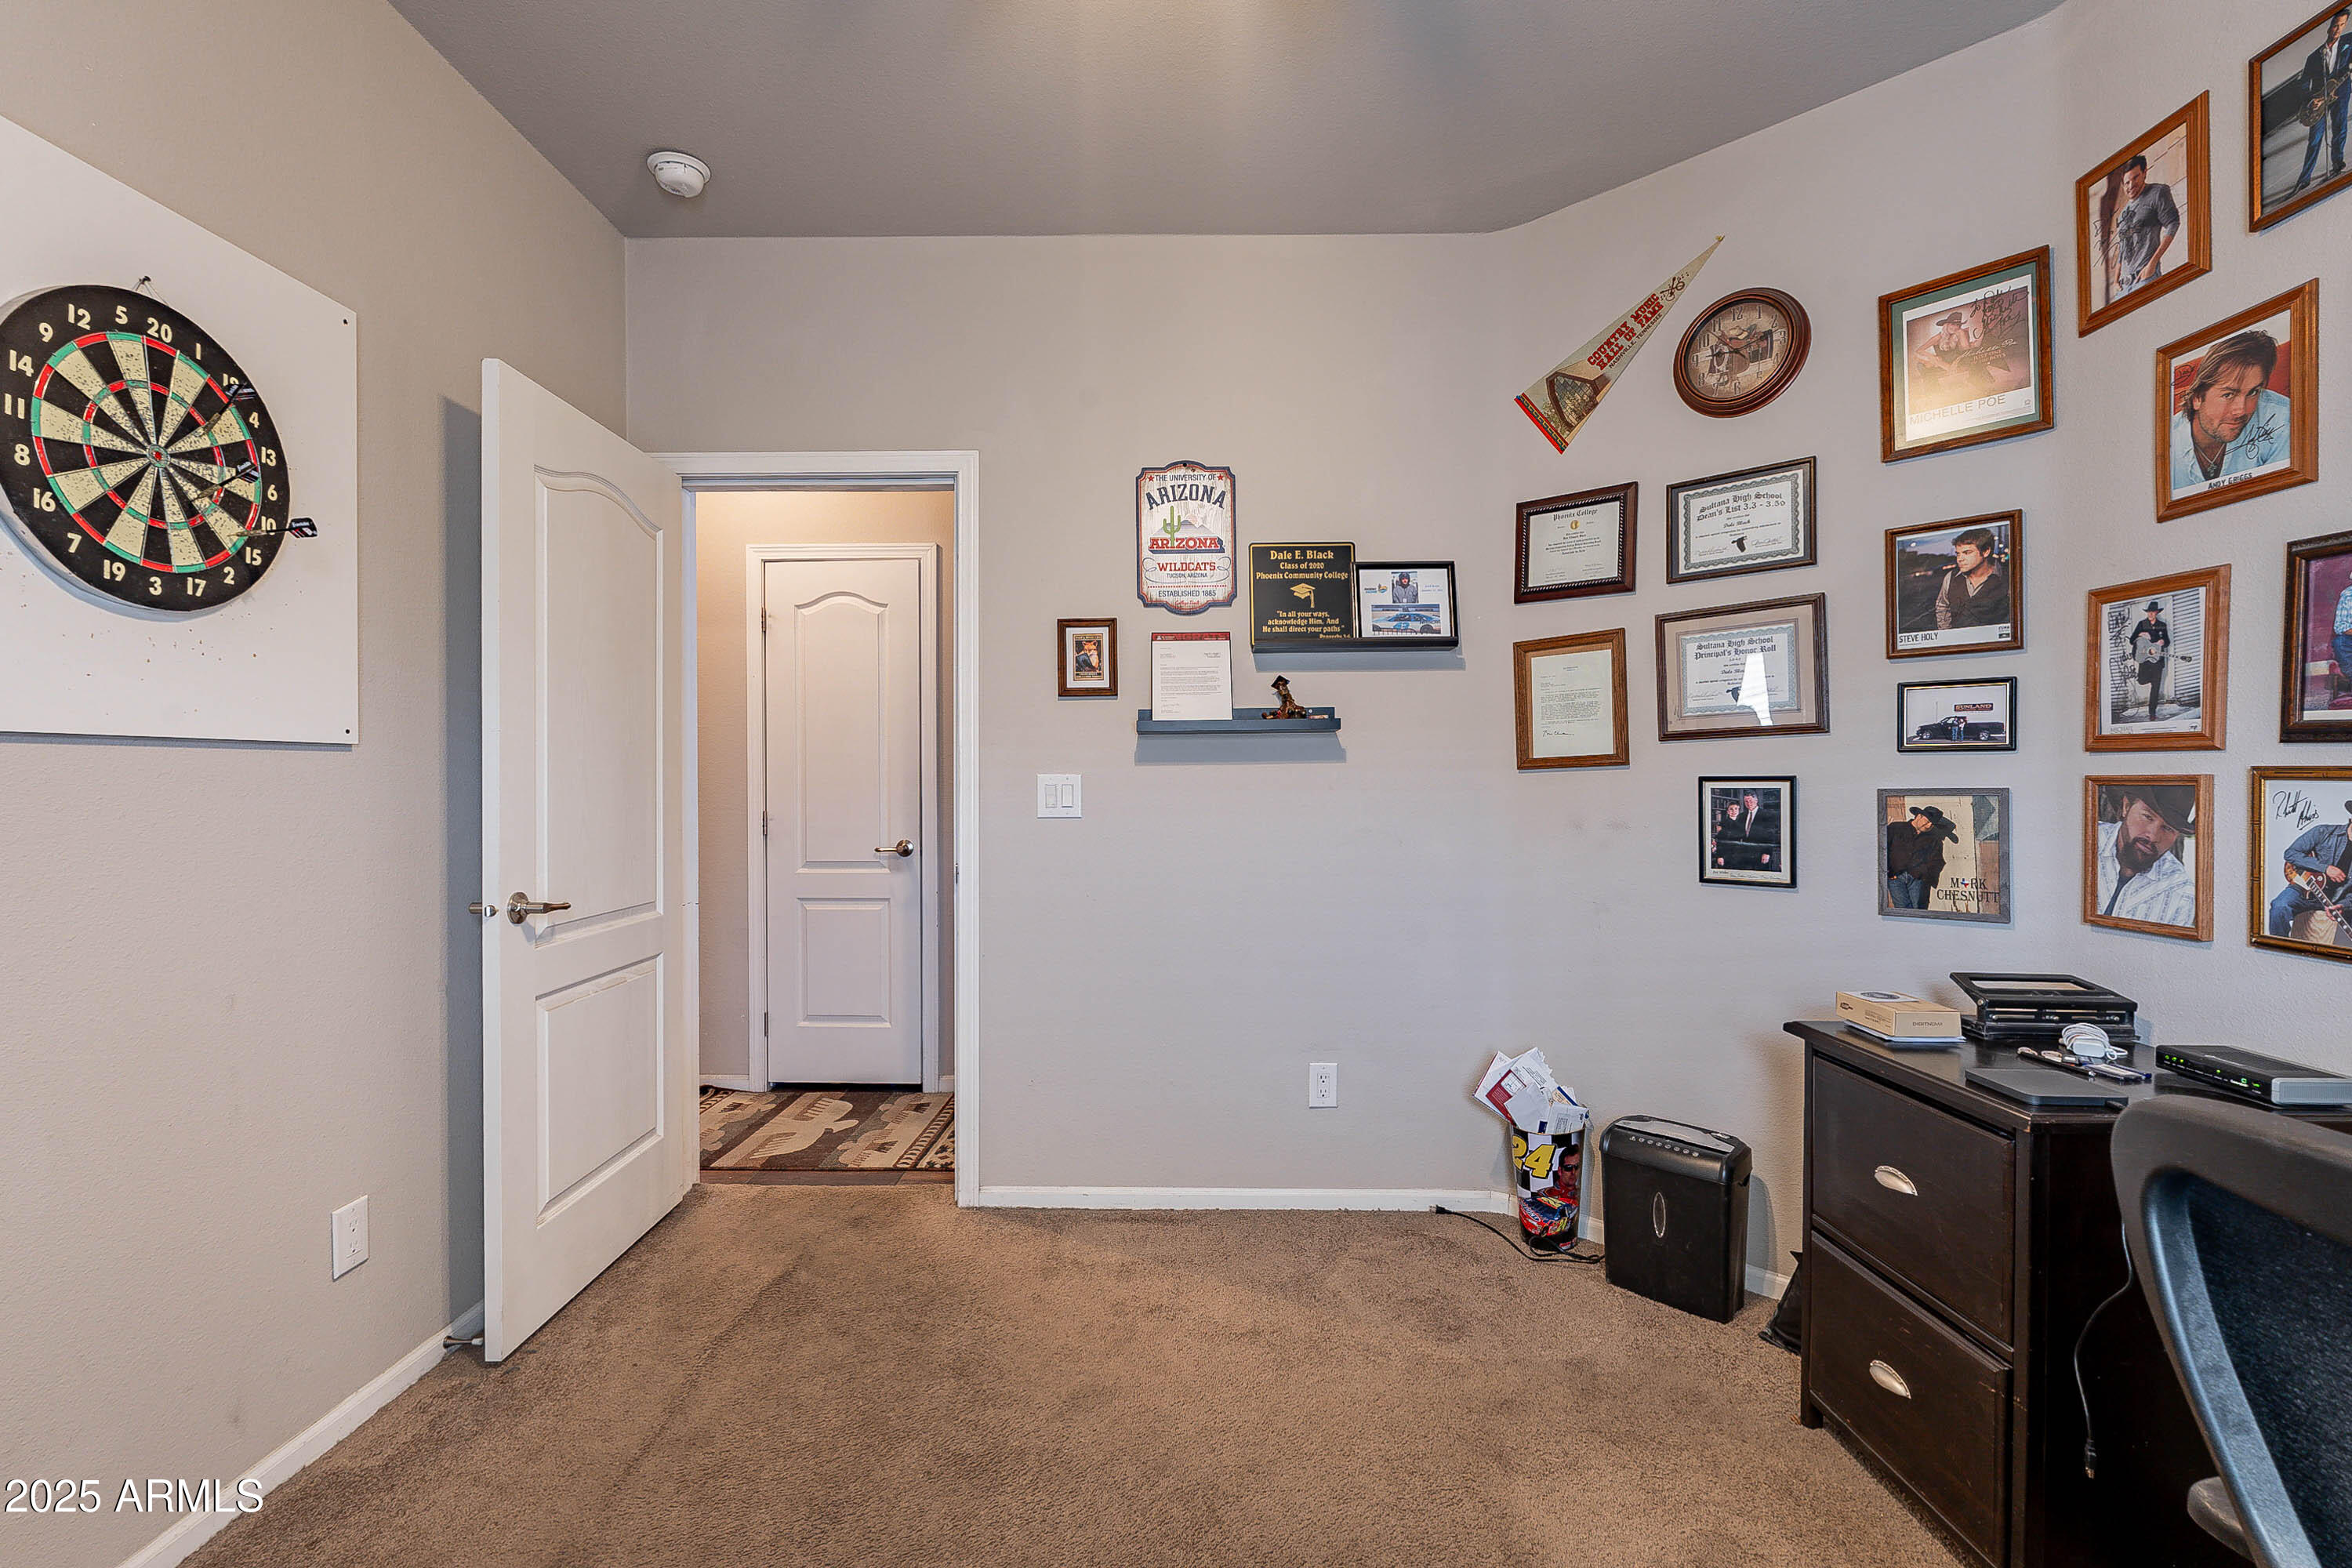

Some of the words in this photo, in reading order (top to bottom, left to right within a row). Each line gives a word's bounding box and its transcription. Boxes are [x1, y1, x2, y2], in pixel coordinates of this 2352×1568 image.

[67, 303, 91, 330] 12
[114, 305, 129, 324] 5
[1731, 306, 1744, 321] 12
[1757, 305, 1762, 319] 1
[1587, 321, 1630, 365] COUNTRY
[1631, 293, 1659, 322] MUSIC
[1635, 313, 1663, 339] TENNESSEE
[1711, 318, 1722, 332] 11
[1770, 314, 1778, 328] 2
[38, 322, 53, 343] 9
[147, 317, 172, 343] 20
[1596, 343, 1624, 371] HALL
[1624, 327, 1637, 342] OF
[1637, 301, 1664, 328] FAME
[1779, 330, 1787, 344] 3
[1697, 334, 1710, 349] 10
[194, 343, 202, 360] 1
[1772, 353, 1780, 365] 4
[9, 350, 34, 377] 14
[1692, 354, 1699, 368] 9
[1698, 372, 1705, 386] 8
[1756, 370, 1763, 380] 5
[1712, 383, 1719, 396] 7
[1733, 381, 1741, 395] 6
[4, 394, 25, 419] 11
[1909, 402, 1973, 426] MICHELLE
[1978, 394, 2006, 409] POE
[249, 412, 260, 428] 4
[14, 444, 31, 466] 8
[261, 447, 277, 466] 13
[267, 483, 278, 501] 6
[2208, 479, 2226, 490] ANDY
[33, 488, 57, 513] 16
[1145, 484, 1226, 510] ARIZONA
[1699, 499, 1730, 514] Sultana
[1732, 493, 1752, 503] High
[1754, 492, 1782, 500] School
[1553, 512, 1576, 521] Phoenix
[1577, 508, 1599, 517] College
[1697, 508, 1723, 521] Dean's
[1725, 504, 1741, 514] List
[261, 515, 277, 535] 10
[67, 533, 82, 553] 7
[1149, 537, 1219, 550] ARIZONA
[245, 546, 262, 565] 15
[1270, 550, 1292, 560] Dale
[1294, 550, 1304, 559] E.
[1306, 550, 1334, 559] Black
[103, 560, 126, 583] 19
[223, 566, 235, 585] 2
[1157, 562, 1216, 572] WILDCATS
[1284, 572, 1323, 580] Community
[1324, 571, 1348, 580] College
[149, 577, 163, 595] 3
[187, 577, 207, 597] 17
[1696, 641, 1725, 651] Sultana
[1726, 638, 1745, 648] High
[1748, 636, 1774, 645] School
[1899, 633, 1919, 643] STEVE
[1921, 632, 1939, 641] HOLY
[1694, 648, 1732, 660] Principal's
[1734, 646, 1757, 656] Honor
[1759, 644, 1777, 653] Roll
[1936, 889, 1999, 903] CHESNUTT
[1512, 1135, 1555, 1179] 24
